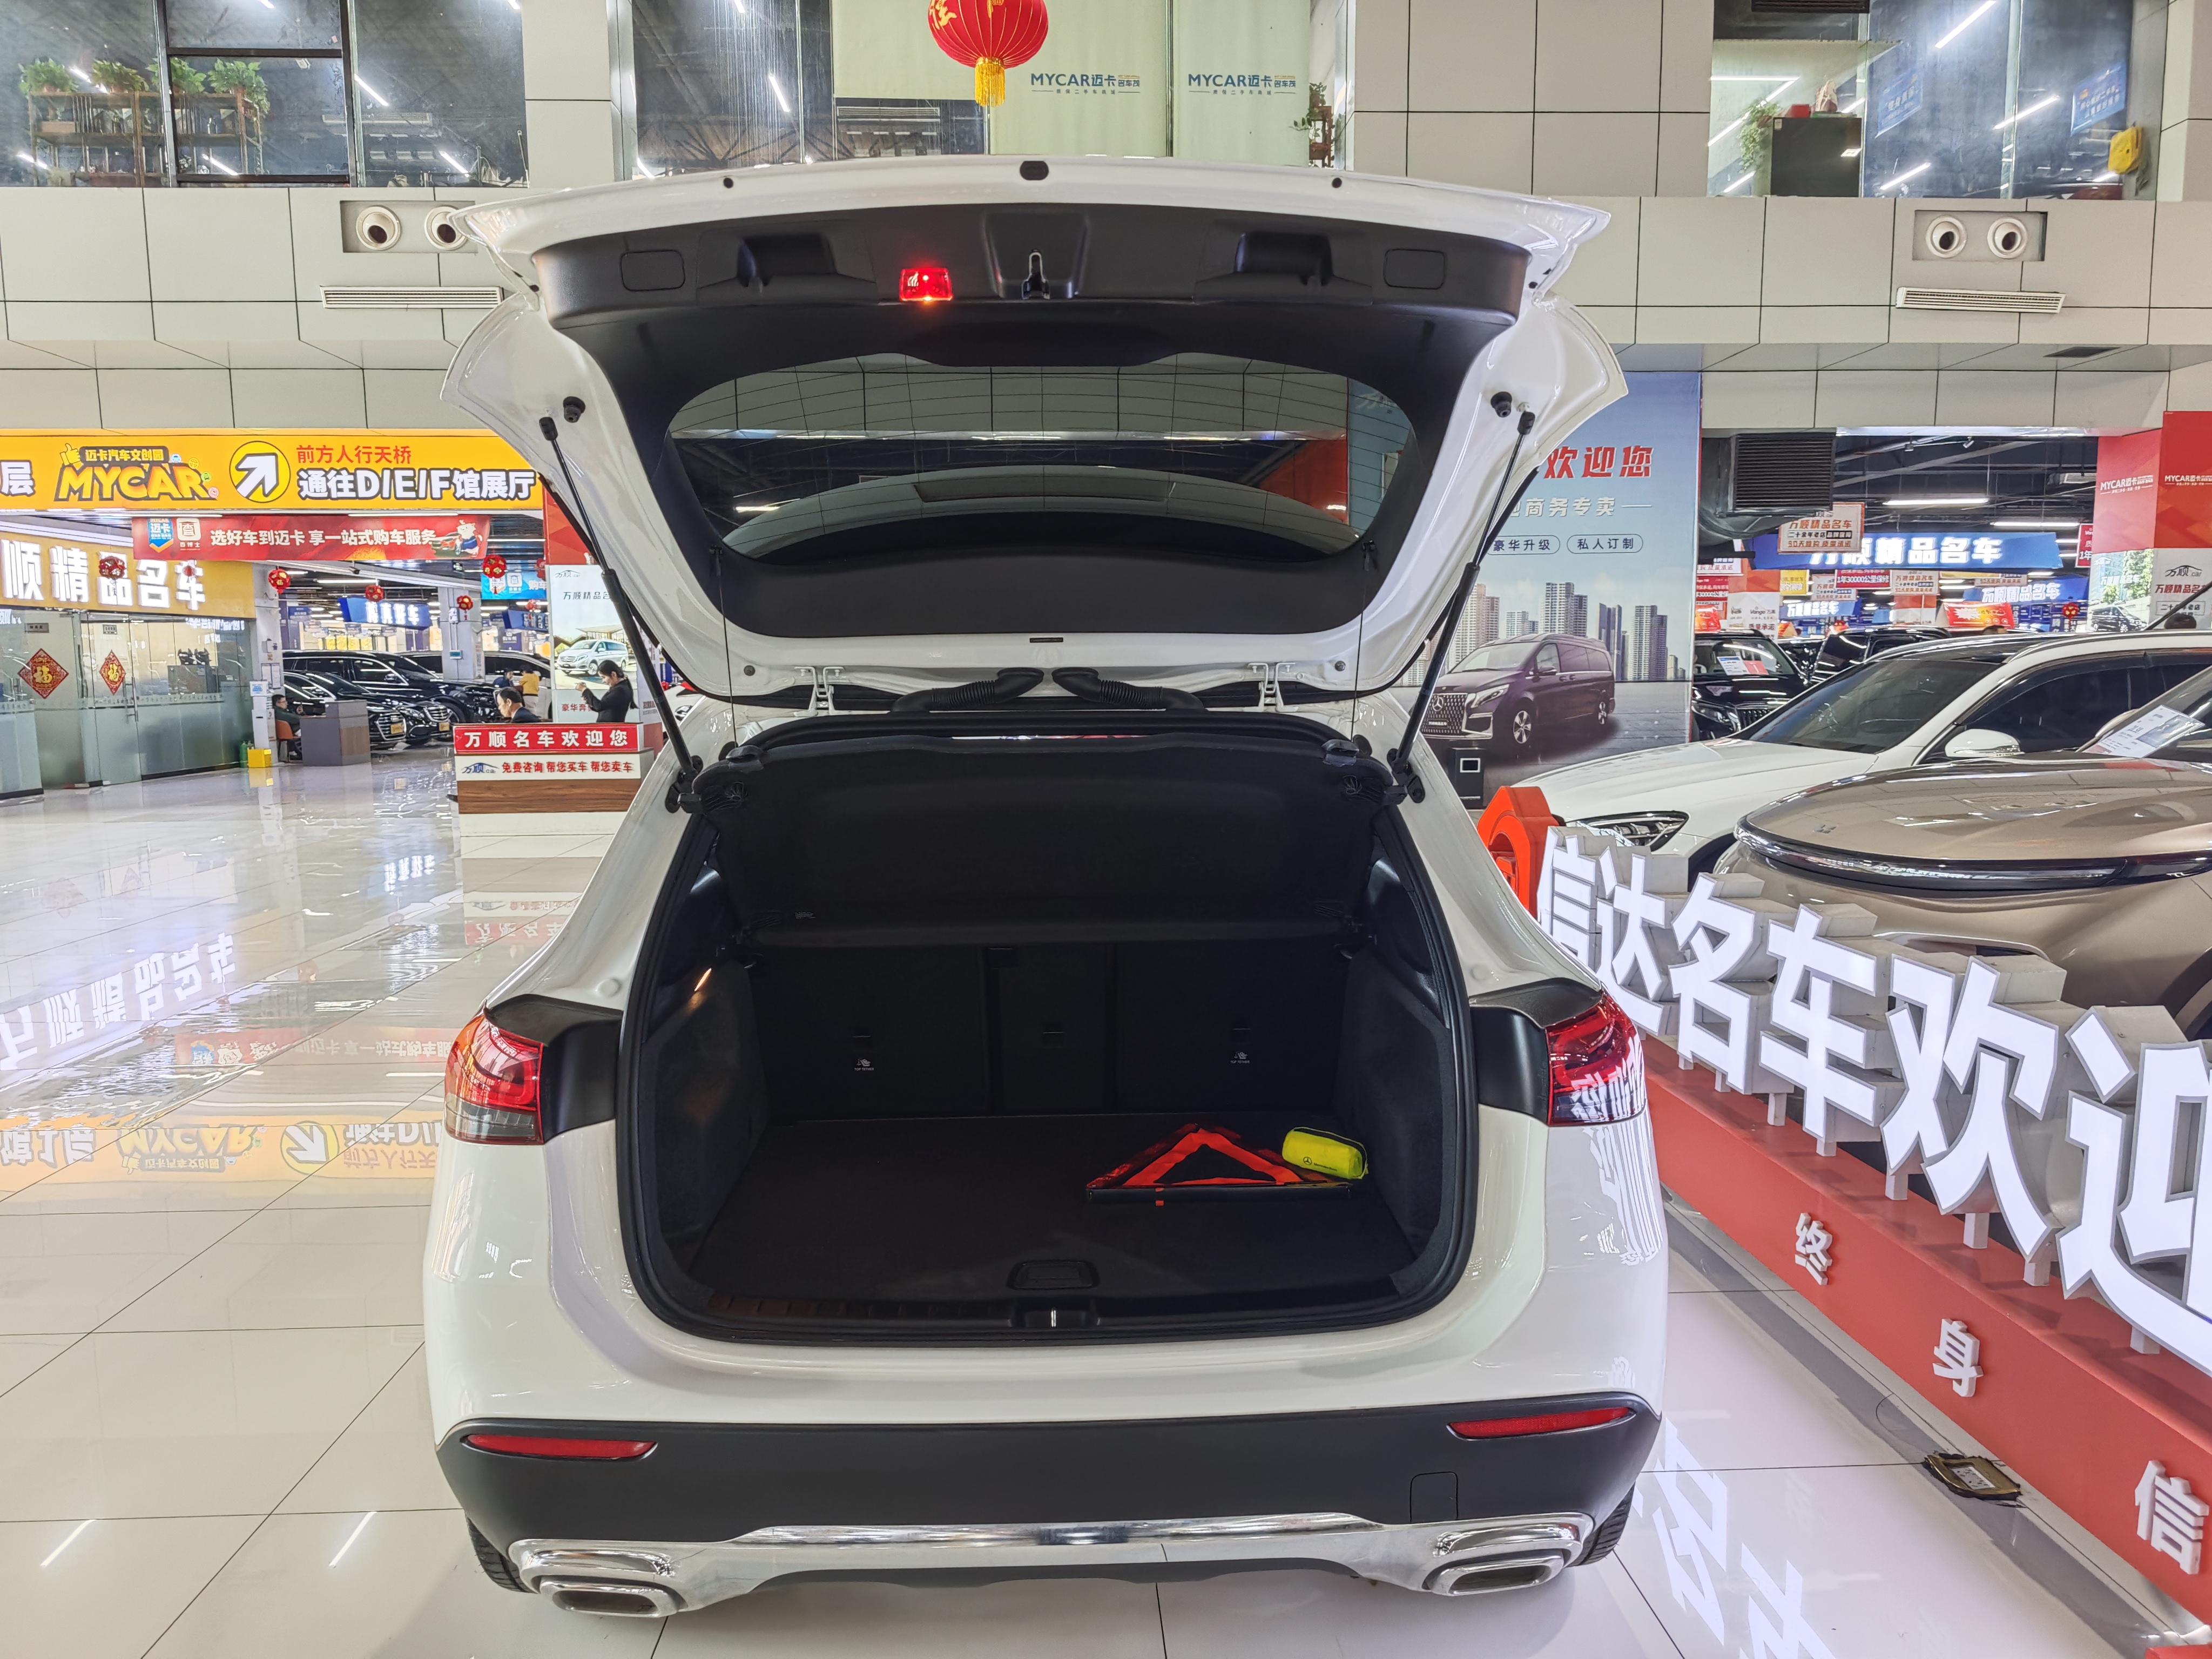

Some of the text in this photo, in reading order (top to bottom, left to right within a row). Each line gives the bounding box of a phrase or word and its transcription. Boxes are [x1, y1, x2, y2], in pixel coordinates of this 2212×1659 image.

[85, 448, 164, 462] 迈卡汽车文创园
[296, 444, 412, 464] 前方人行天桥
[1543, 444, 1654, 480] 欢迎您
[1, 461, 34, 495] 层
[57, 464, 213, 500] MYCAR
[150, 523, 171, 533] 迈卡
[210, 529, 437, 546] 选好车到迈卡 享一站式购车服务
[1493, 537, 1634, 551] 豪华升级 私人订制
[0, 539, 205, 611] 顺精品名车
[33, 665, 53, 684] 福
[107, 663, 119, 682] 福
[464, 730, 628, 748] 万顺名车欢迎您
[502, 761, 543, 773] 免费咨询
[546, 761, 588, 773] 帮您买车
[590, 761, 635, 772] 帮您卖车
